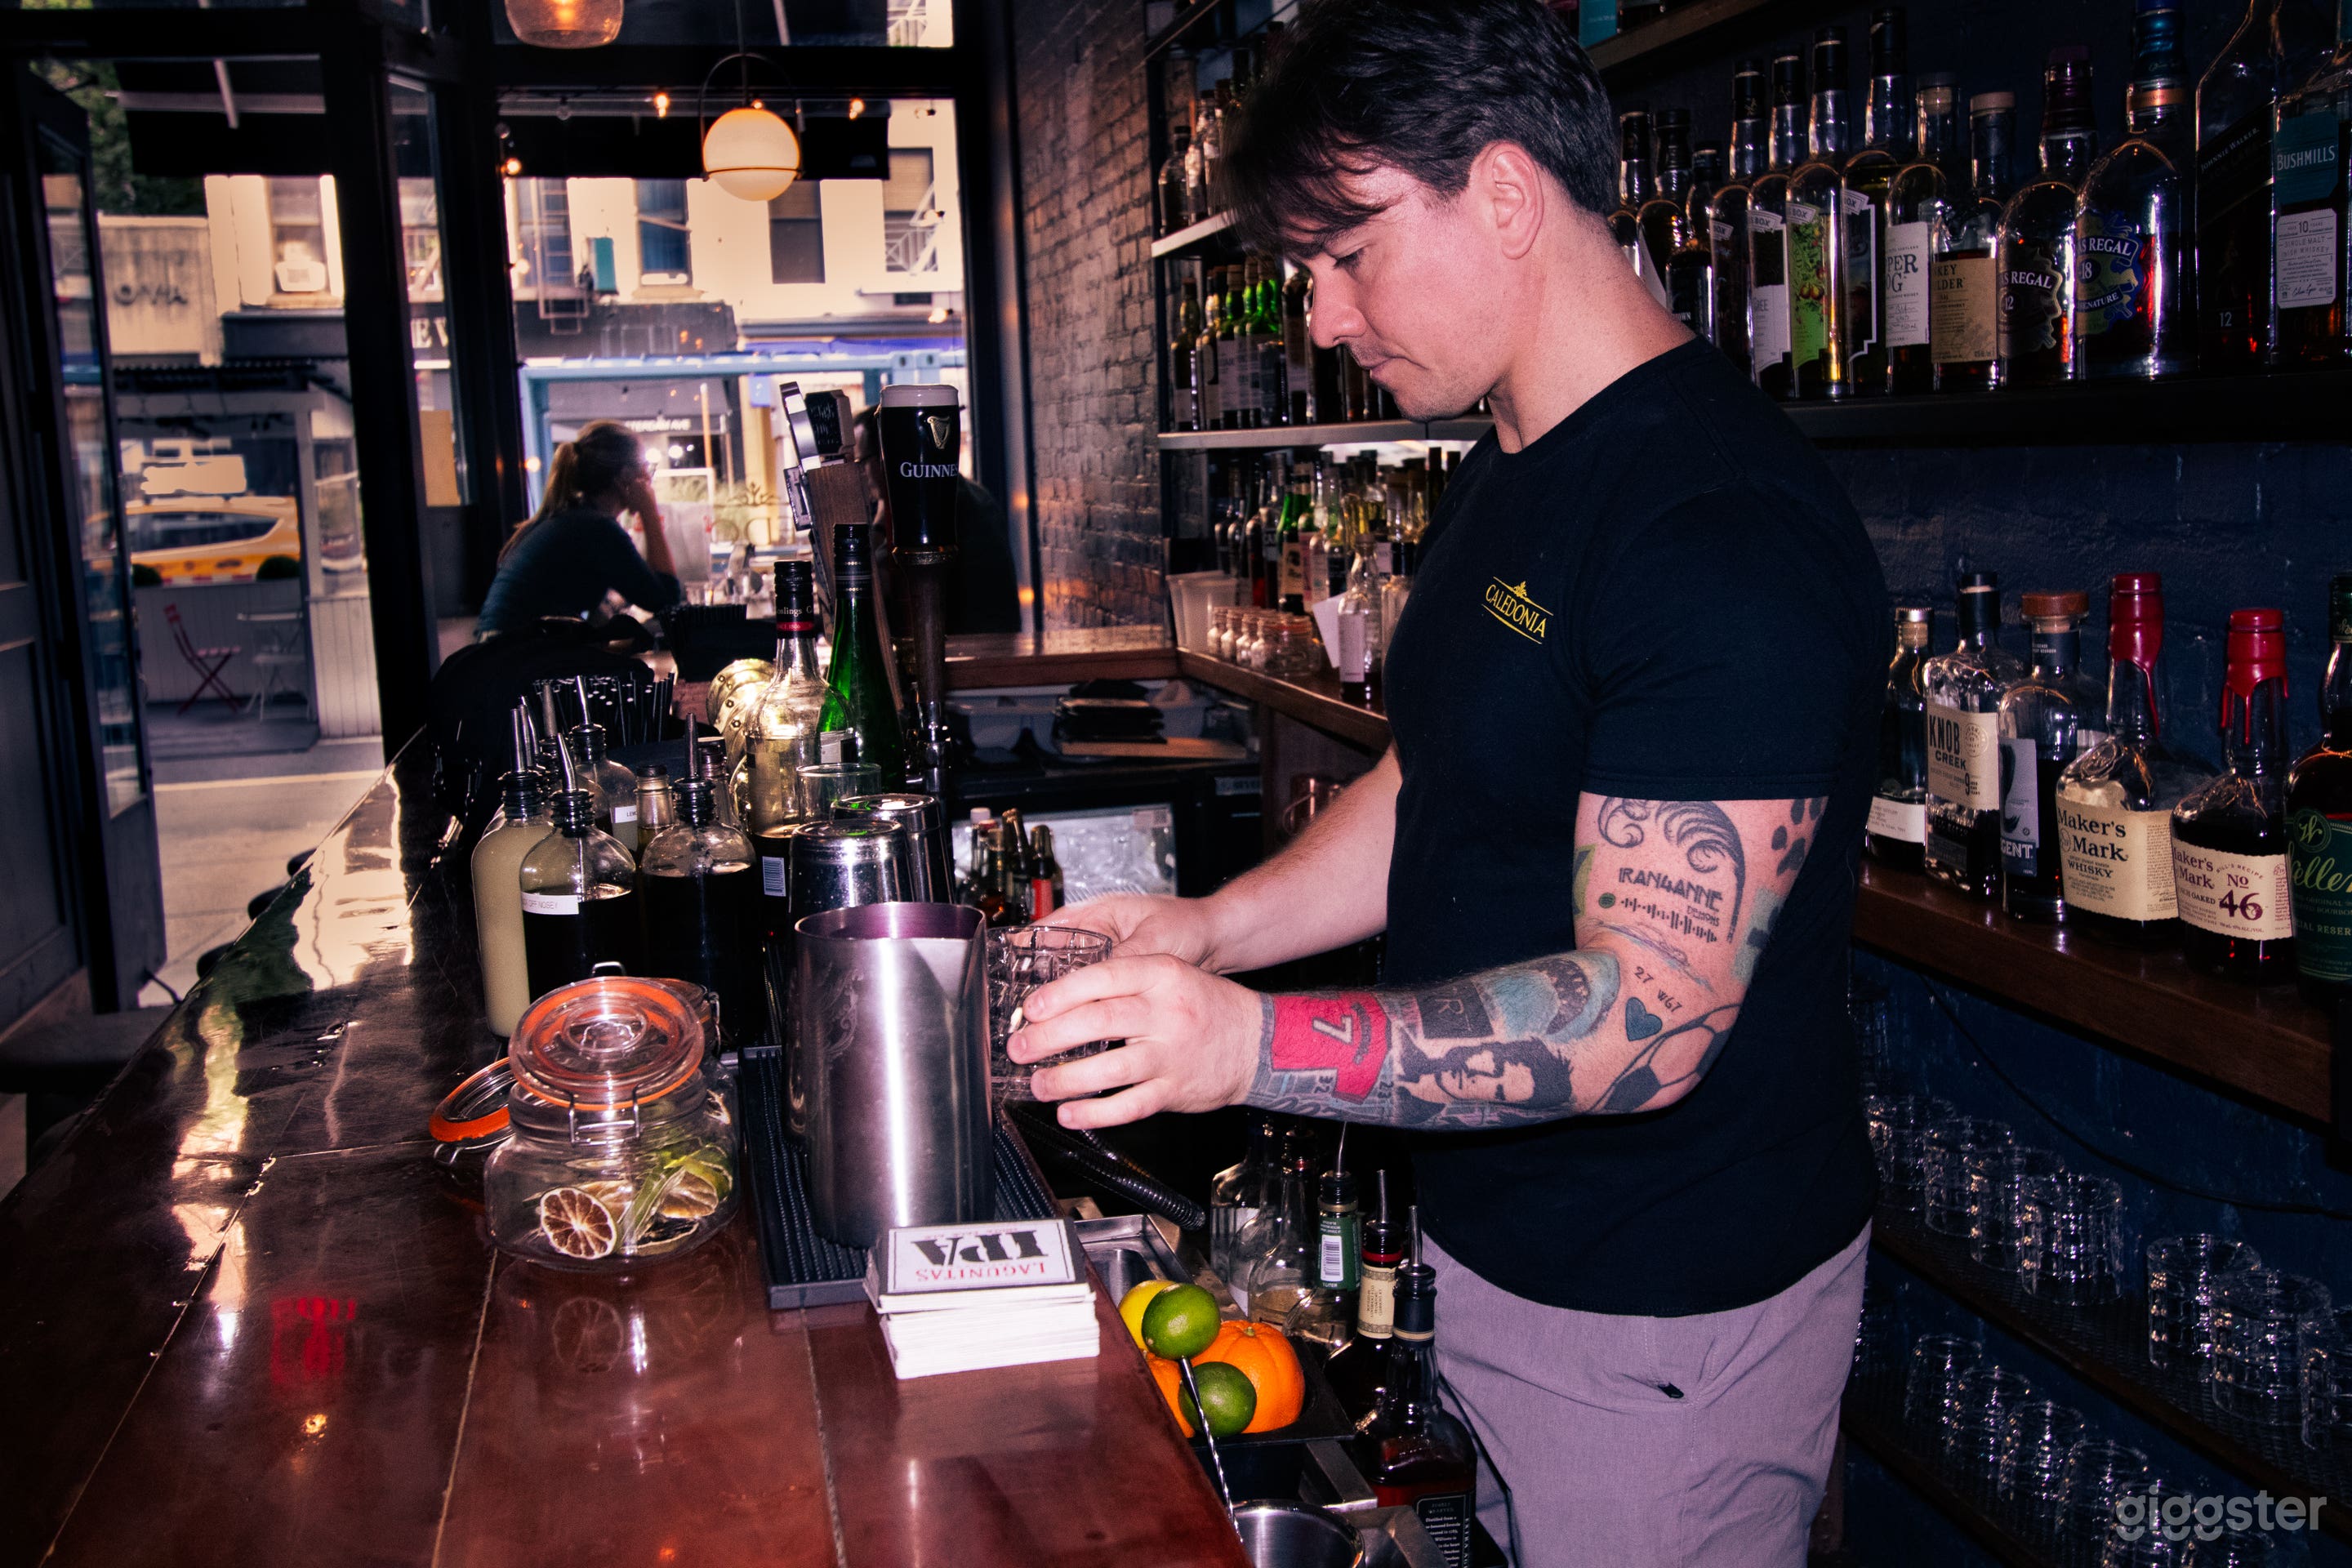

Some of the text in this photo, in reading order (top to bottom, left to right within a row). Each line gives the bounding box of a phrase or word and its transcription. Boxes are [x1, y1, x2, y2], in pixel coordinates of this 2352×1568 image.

[2277, 145, 2336, 171] BUSHMILLS
[2299, 220, 2309, 234] 10
[2089, 238, 2132, 256] REGAL
[2308, 236, 2326, 245] MALT
[2011, 271, 2053, 289] REGAL
[2082, 262, 2093, 279] 18
[2004, 297, 2015, 310] 12
[2219, 311, 2233, 327] 12
[1486, 584, 1548, 639] CALEDONIA
[1930, 715, 1961, 755] KNOB
[1936, 751, 1967, 770] CREEK
[1965, 773, 1971, 795] 9
[2058, 808, 2127, 838] Maker's
[2073, 835, 2128, 862] Mark
[2068, 860, 2114, 878] WHISKY
[2180, 867, 2215, 889] Mark
[2192, 893, 2216, 905] OAKED
[2219, 889, 2264, 921] 46
[1634, 965, 1654, 984] 27
[1312, 1014, 1353, 1045] 7
[911, 1230, 1049, 1267] IPA
[915, 1263, 1045, 1281] LAGUNITAS
